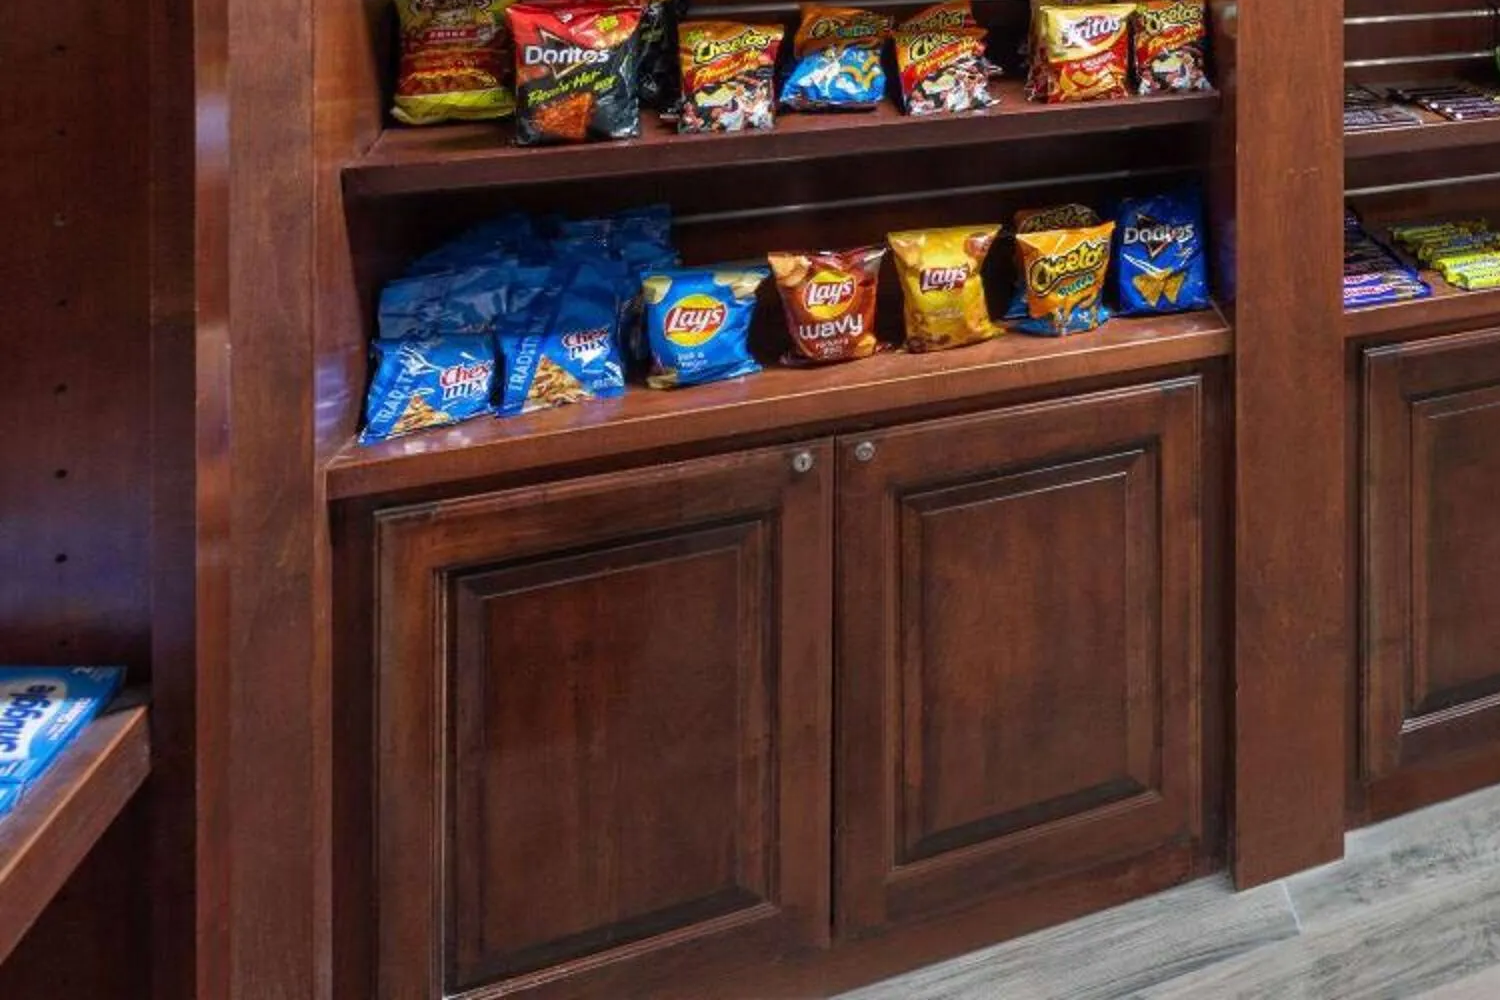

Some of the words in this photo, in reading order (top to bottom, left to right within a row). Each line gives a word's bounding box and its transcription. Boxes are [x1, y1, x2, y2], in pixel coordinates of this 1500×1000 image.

[525, 46, 611, 65] Doritos
[562, 326, 610, 347] Chex
[800, 313, 864, 339] wavy
[440, 361, 494, 387] Chex
[442, 378, 489, 401] mix
